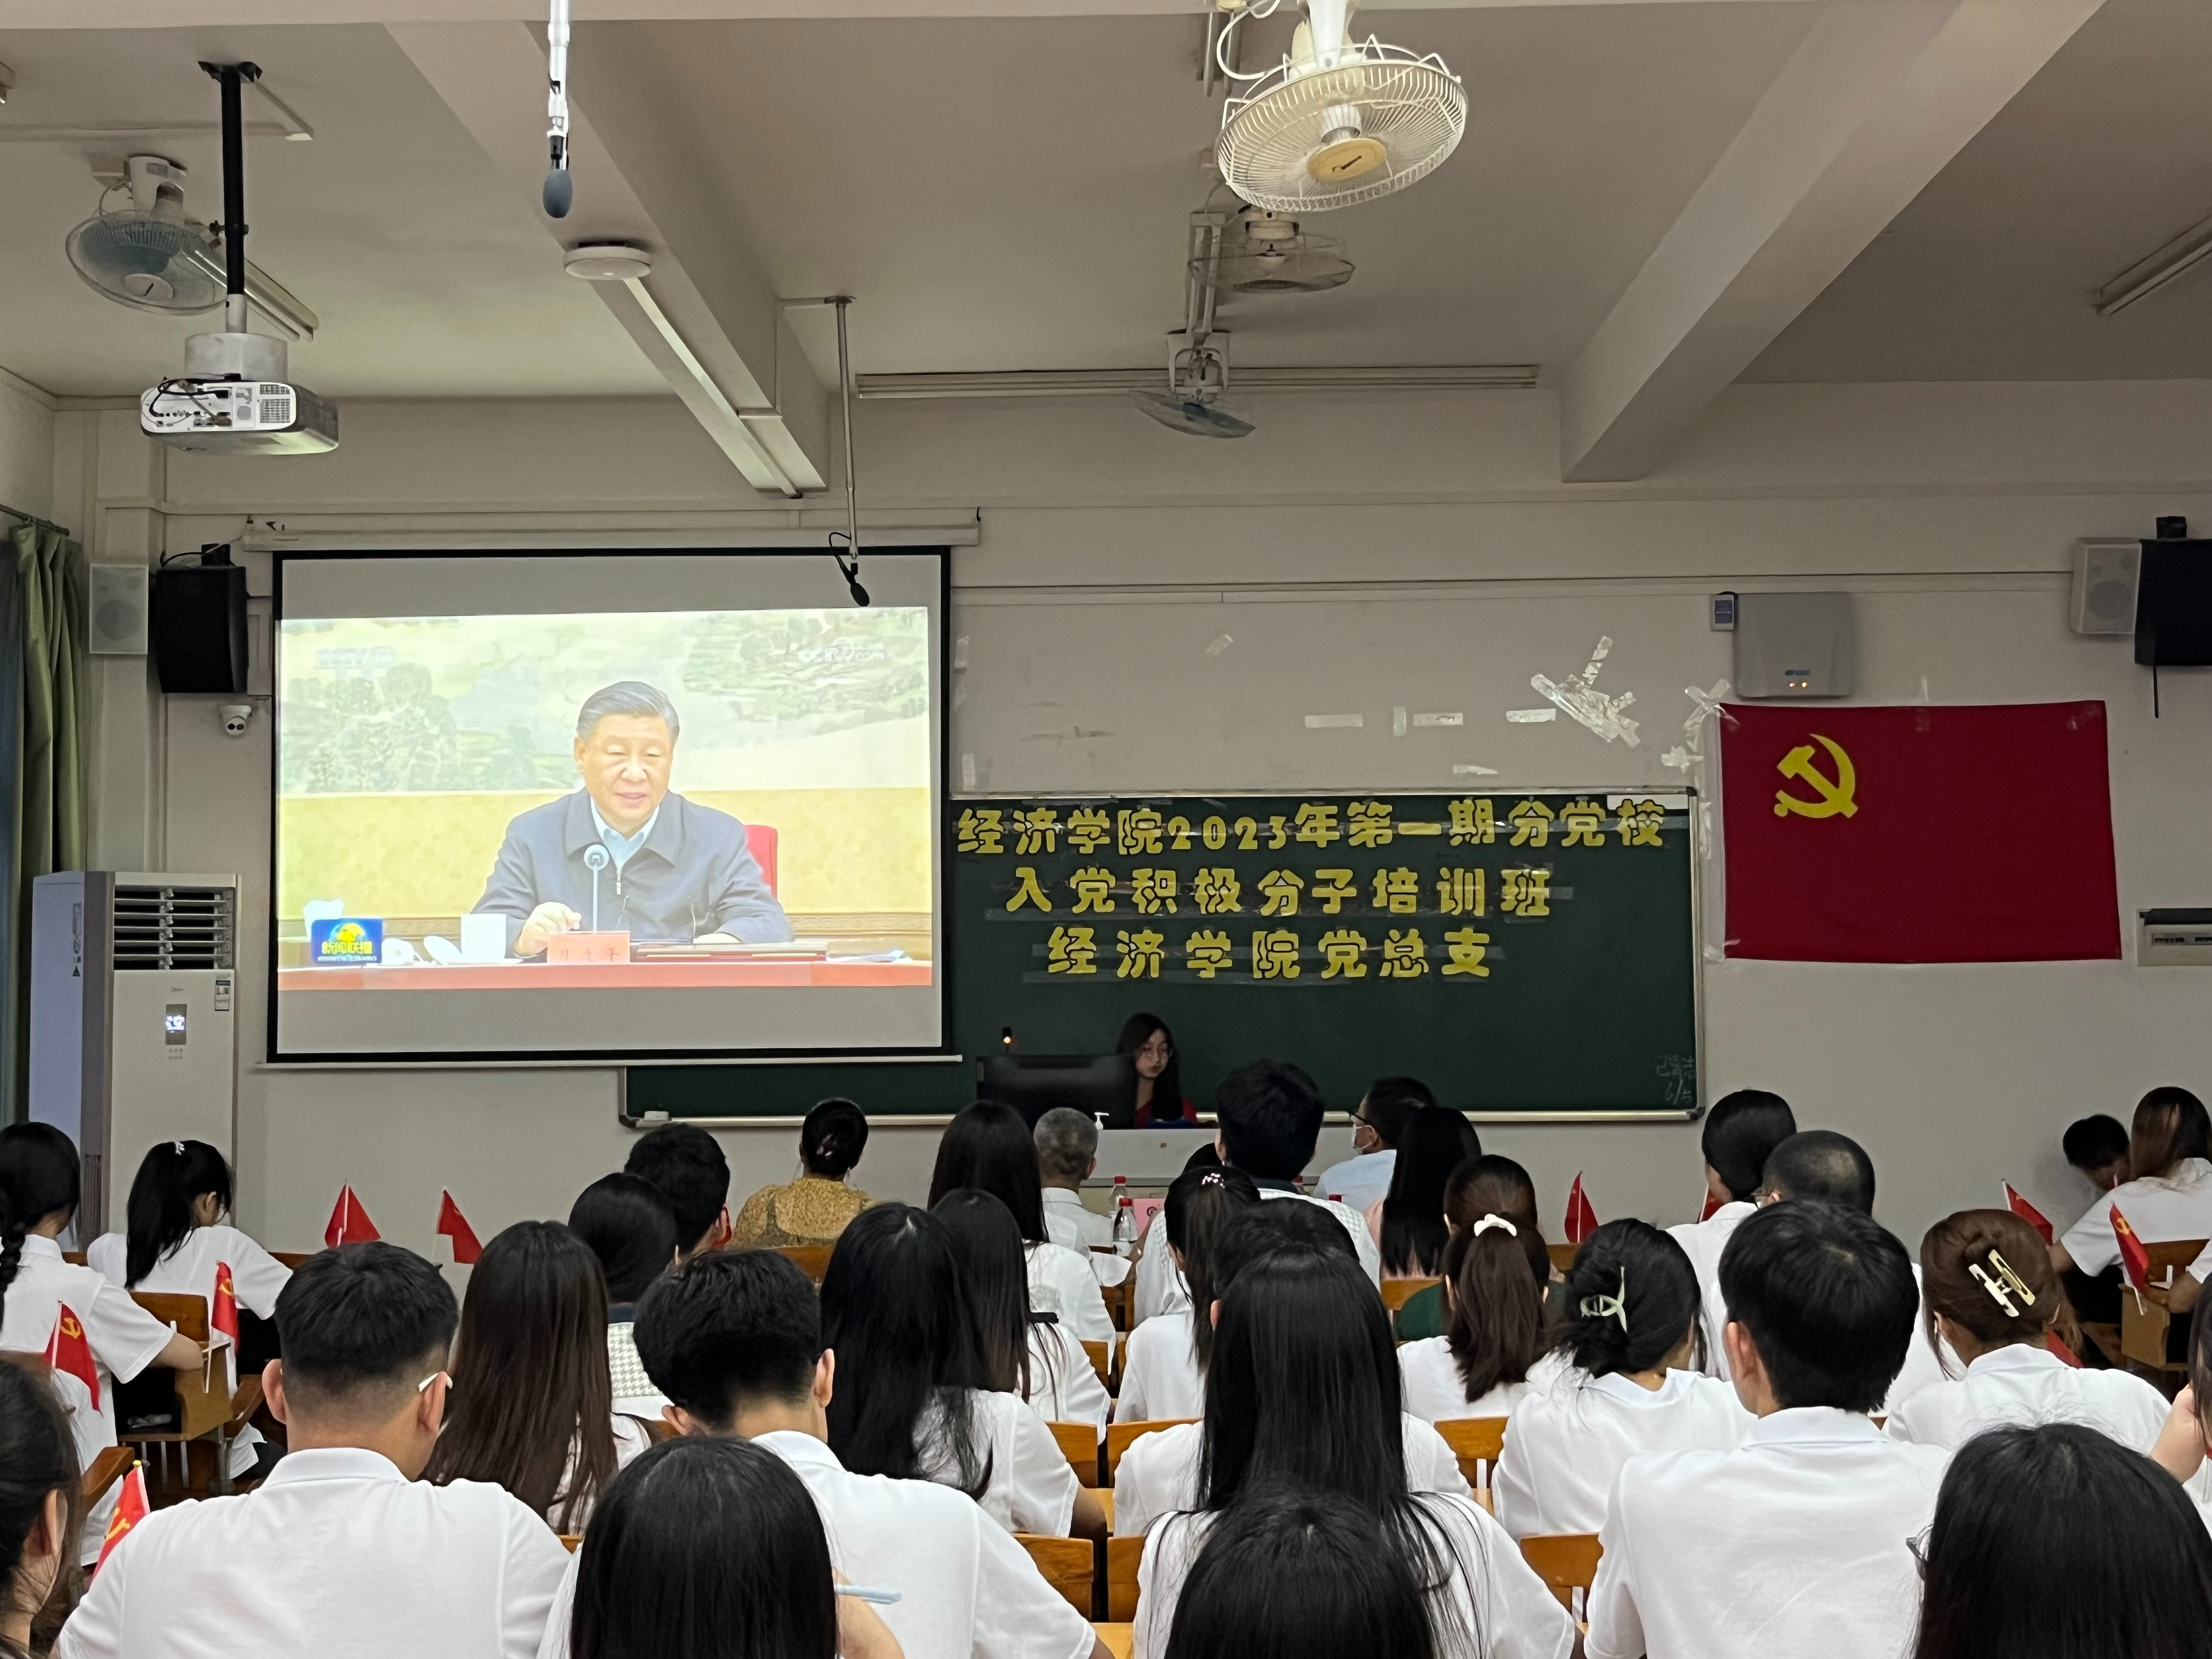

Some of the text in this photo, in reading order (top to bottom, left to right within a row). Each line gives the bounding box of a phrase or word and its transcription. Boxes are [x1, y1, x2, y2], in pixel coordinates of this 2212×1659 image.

[958, 799, 1665, 855] 经济学院2023年第一期分党校
[1006, 867, 1550, 916] 入党积极分子培训班
[1047, 926, 1490, 979] 经济学院党总支
